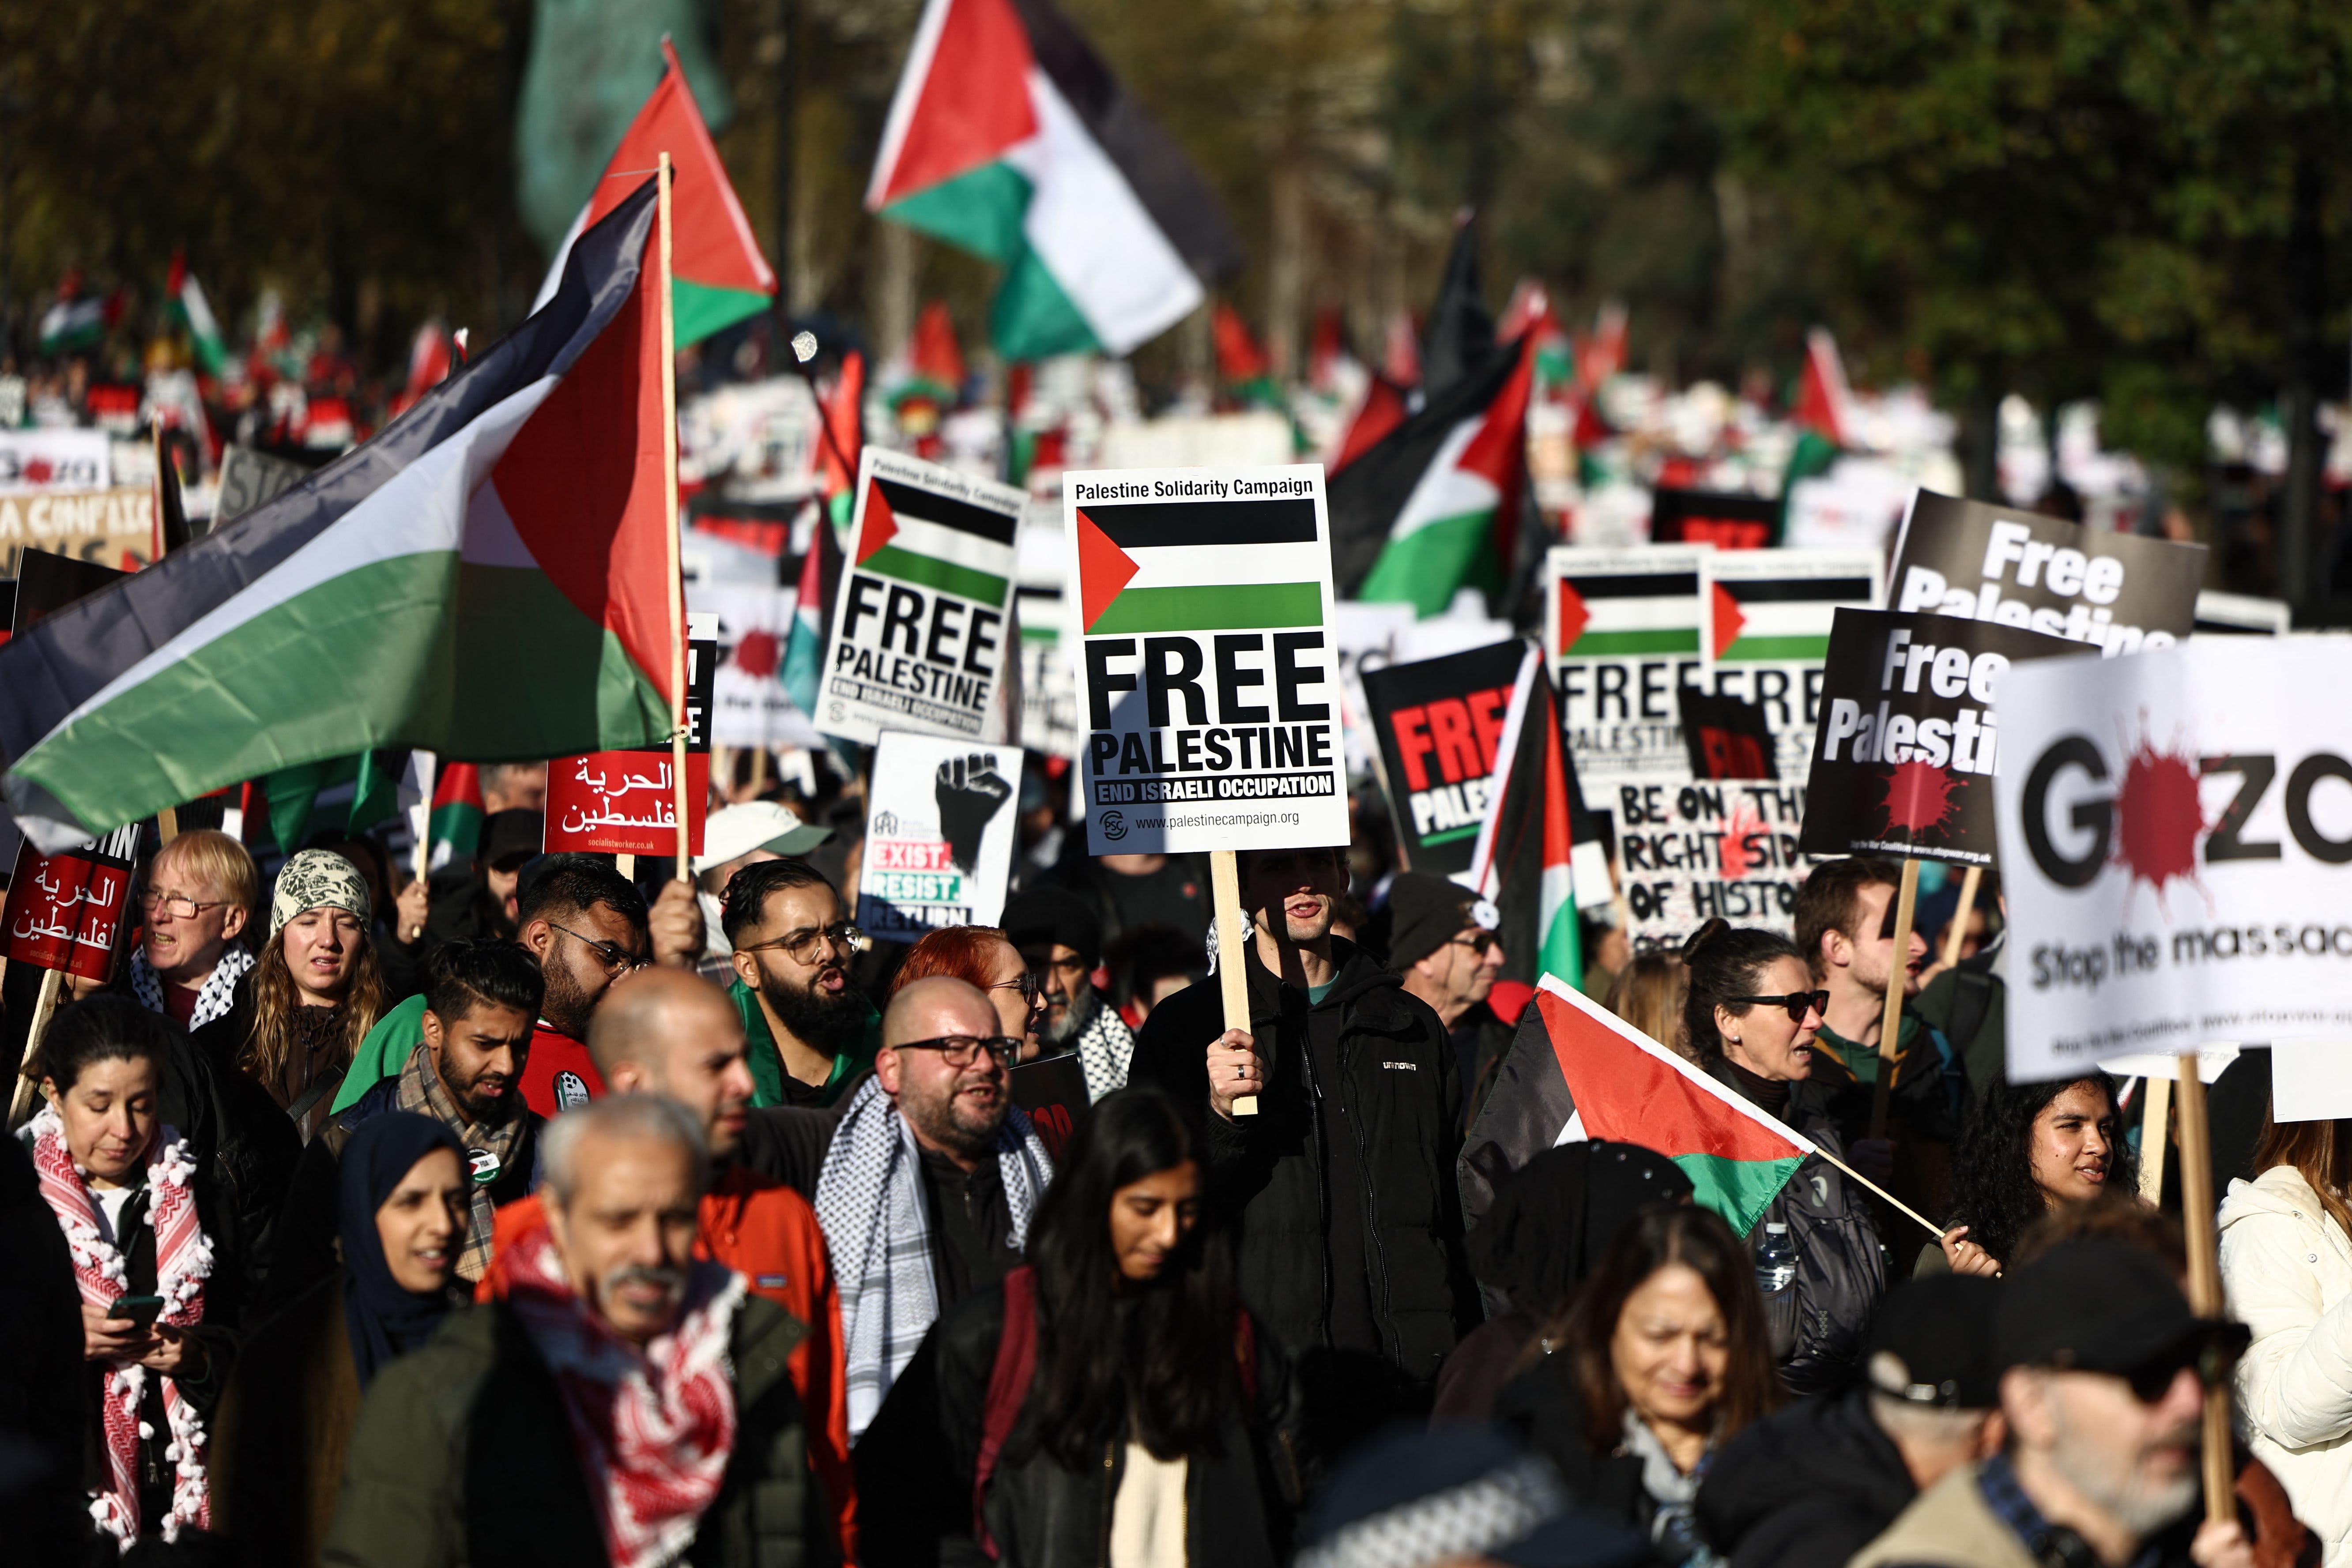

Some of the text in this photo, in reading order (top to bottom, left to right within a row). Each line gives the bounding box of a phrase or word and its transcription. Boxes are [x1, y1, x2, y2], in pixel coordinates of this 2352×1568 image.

[1075, 477, 1313, 500] Palestine Solidarity Campaign
[1983, 520, 2124, 605] Free
[843, 574, 1001, 677] FREE
[837, 643, 991, 712] PALESTINE
[1084, 631, 1330, 730] FREE
[1882, 629, 2010, 704] Free
[833, 678, 858, 698] END
[912, 699, 982, 734] OCCUPATION
[1091, 725, 1333, 776] PALESTINE
[1391, 683, 1515, 792] FRE
[1824, 699, 1998, 776] Palesti
[575, 757, 672, 797] الحرية
[1097, 774, 1332, 802] END ISRAELI OCCUPATION
[562, 796, 678, 833] فلسطين
[1104, 821, 1123, 831] PSC
[1136, 812, 1300, 830] www.palestinecampaign.org
[1620, 787, 1807, 825] BE ON TH
[588, 838, 654, 850] socialistworker.co.uk
[874, 844, 951, 869] EXIST.
[1624, 832, 1823, 872] RIGHT SID
[1881, 841, 1911, 853] Coalition
[1912, 844, 1992, 863] www.stopwar.org.uk
[34, 861, 116, 908] الحرية
[872, 873, 961, 901] RESIST.
[1630, 880, 1799, 921] OF HISTO
[13, 906, 117, 951] لفلسطين
[2032, 937, 2109, 991] Stop
[2113, 927, 2160, 976] the
